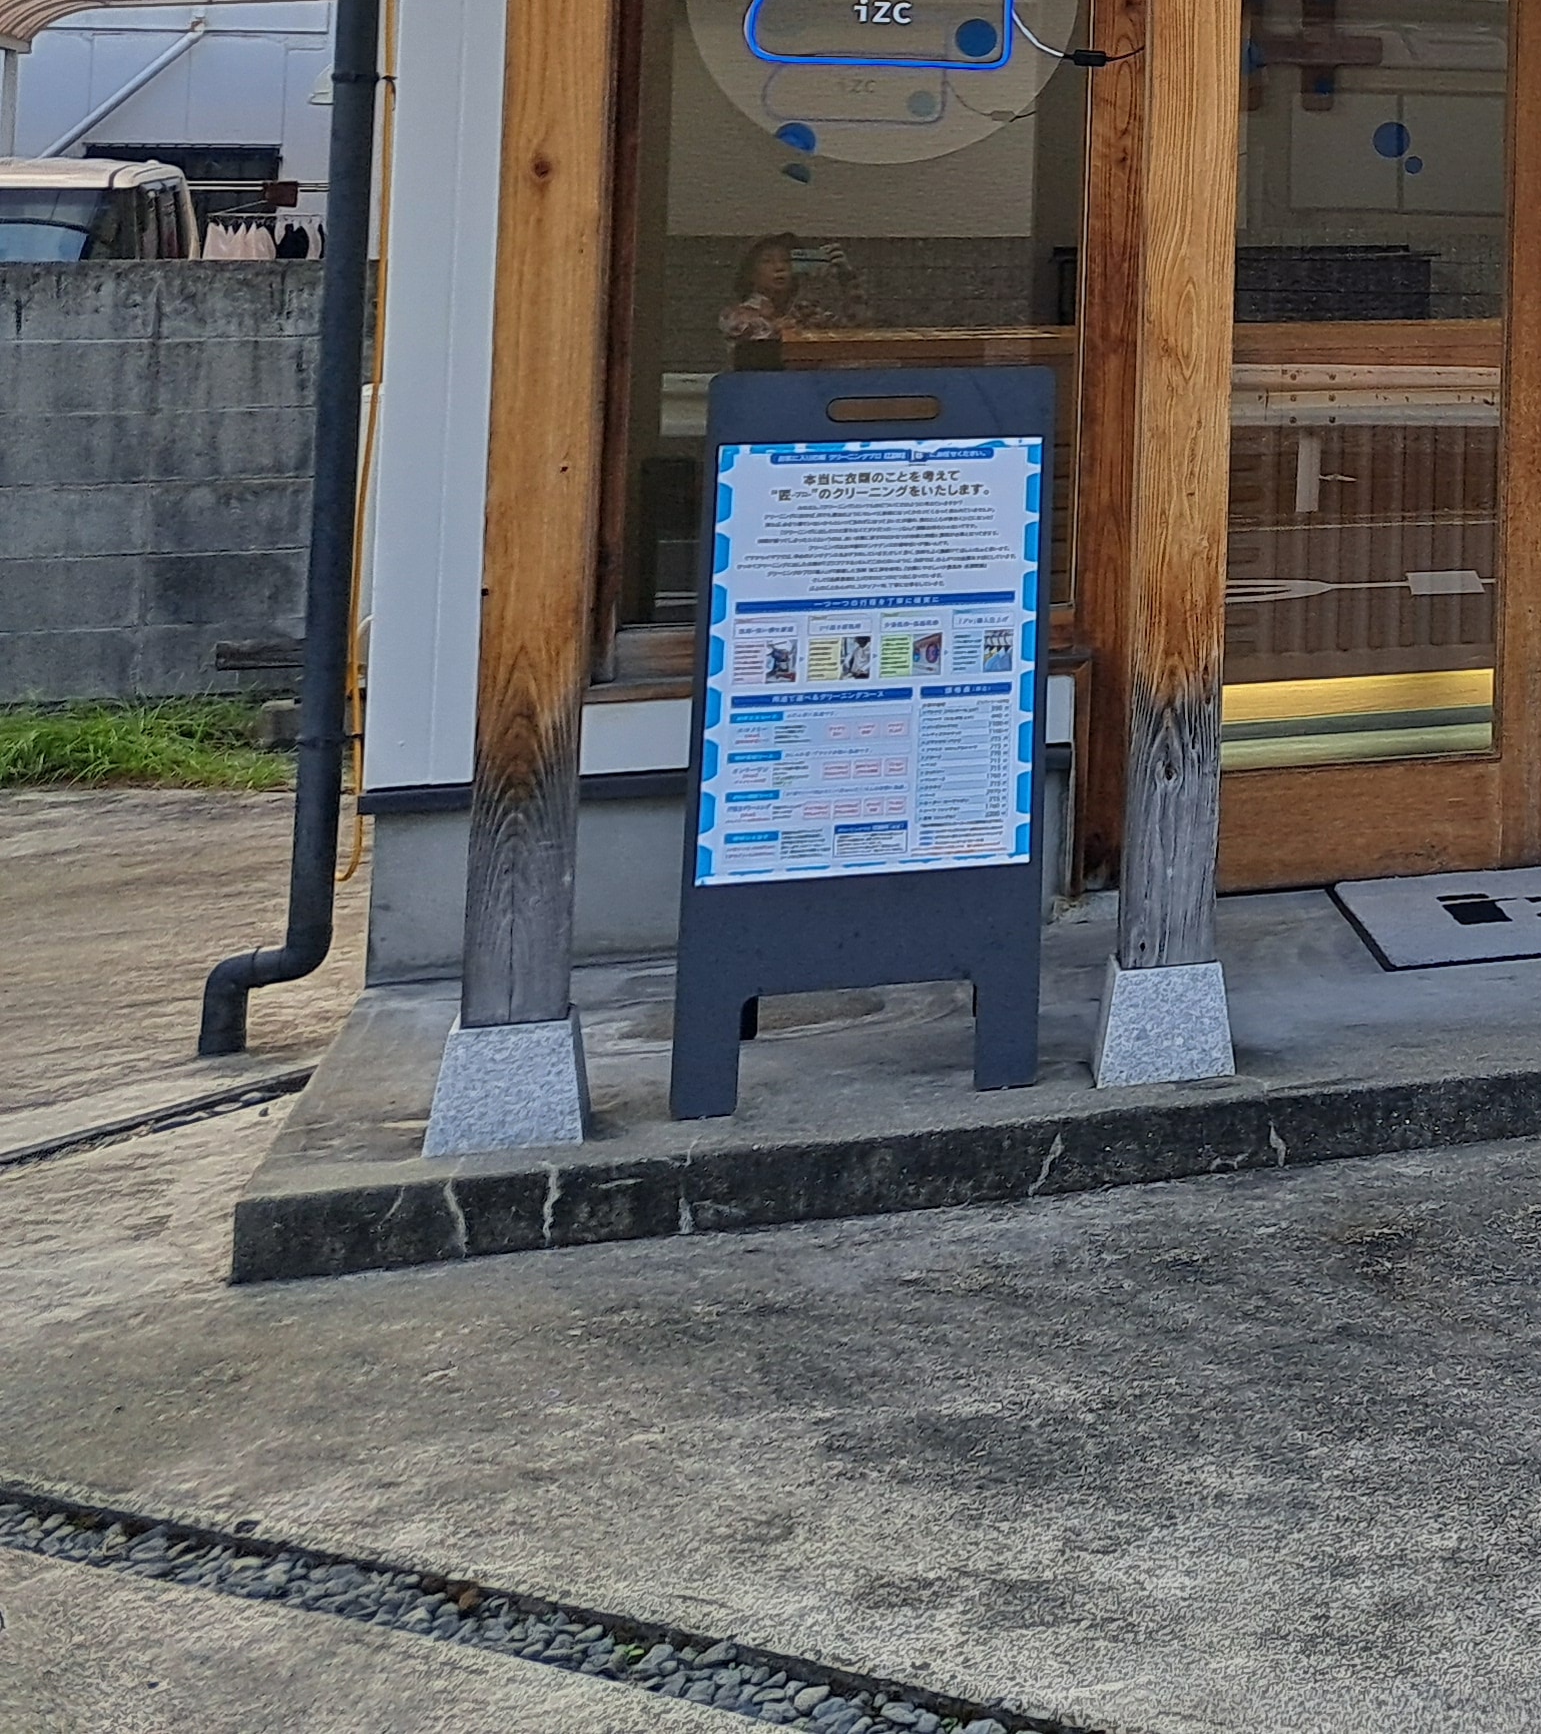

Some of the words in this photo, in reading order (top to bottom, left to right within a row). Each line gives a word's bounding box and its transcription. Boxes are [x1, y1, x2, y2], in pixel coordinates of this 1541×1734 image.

[803, 470, 961, 486] 本当に衣類のことを考えて
